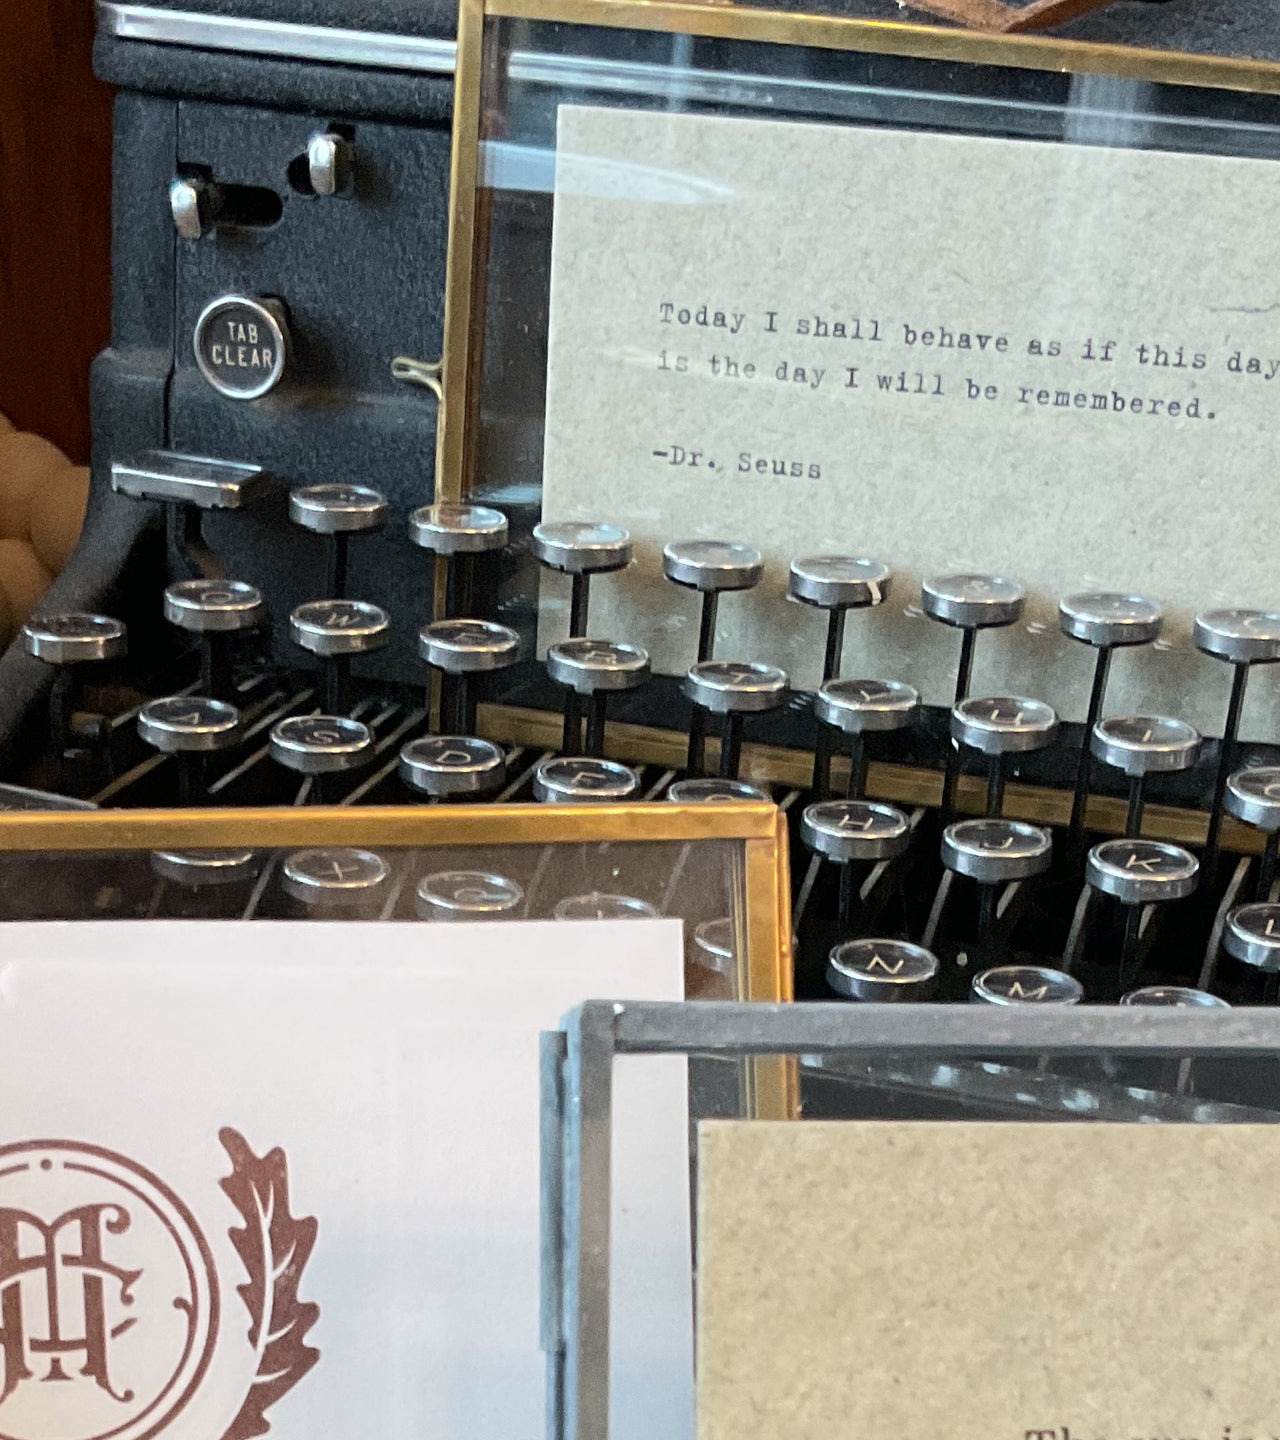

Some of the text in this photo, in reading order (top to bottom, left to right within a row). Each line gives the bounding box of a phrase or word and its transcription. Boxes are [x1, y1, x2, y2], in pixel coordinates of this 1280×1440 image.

[227, 321, 259, 344] TAB
[659, 302, 746, 334] Today
[764, 311, 779, 333] I
[796, 316, 882, 342] shall
[903, 323, 1009, 353] behave
[1026, 338, 1062, 358] as
[1081, 338, 1117, 361] if
[1135, 343, 1207, 369] this
[212, 345, 273, 369] CLEAR
[656, 350, 1217, 420] is the day I will be remembered.
[652, 445, 822, 480] -Dr. Seuss
[1124, 853, 1162, 873] K
[866, 954, 905, 975] N
